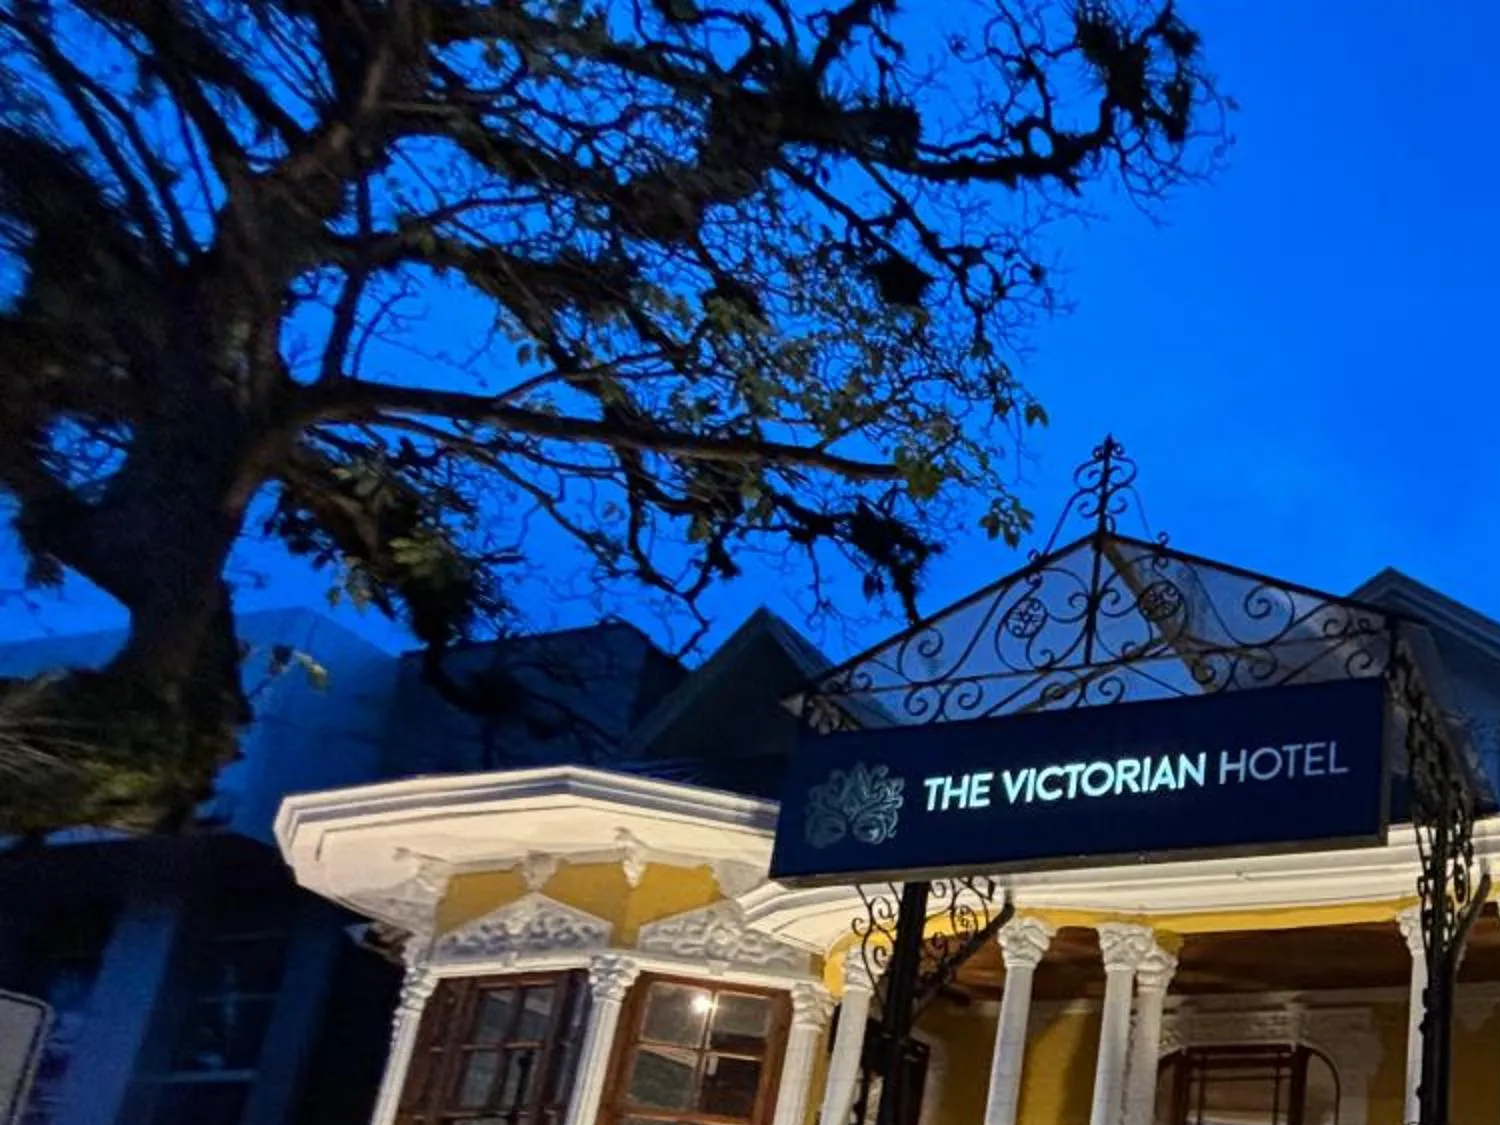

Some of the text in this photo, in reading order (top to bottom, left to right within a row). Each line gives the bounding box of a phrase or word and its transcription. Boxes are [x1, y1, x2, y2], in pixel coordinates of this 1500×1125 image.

[923, 741, 1348, 811] THE VICTORIAN HOTEL
